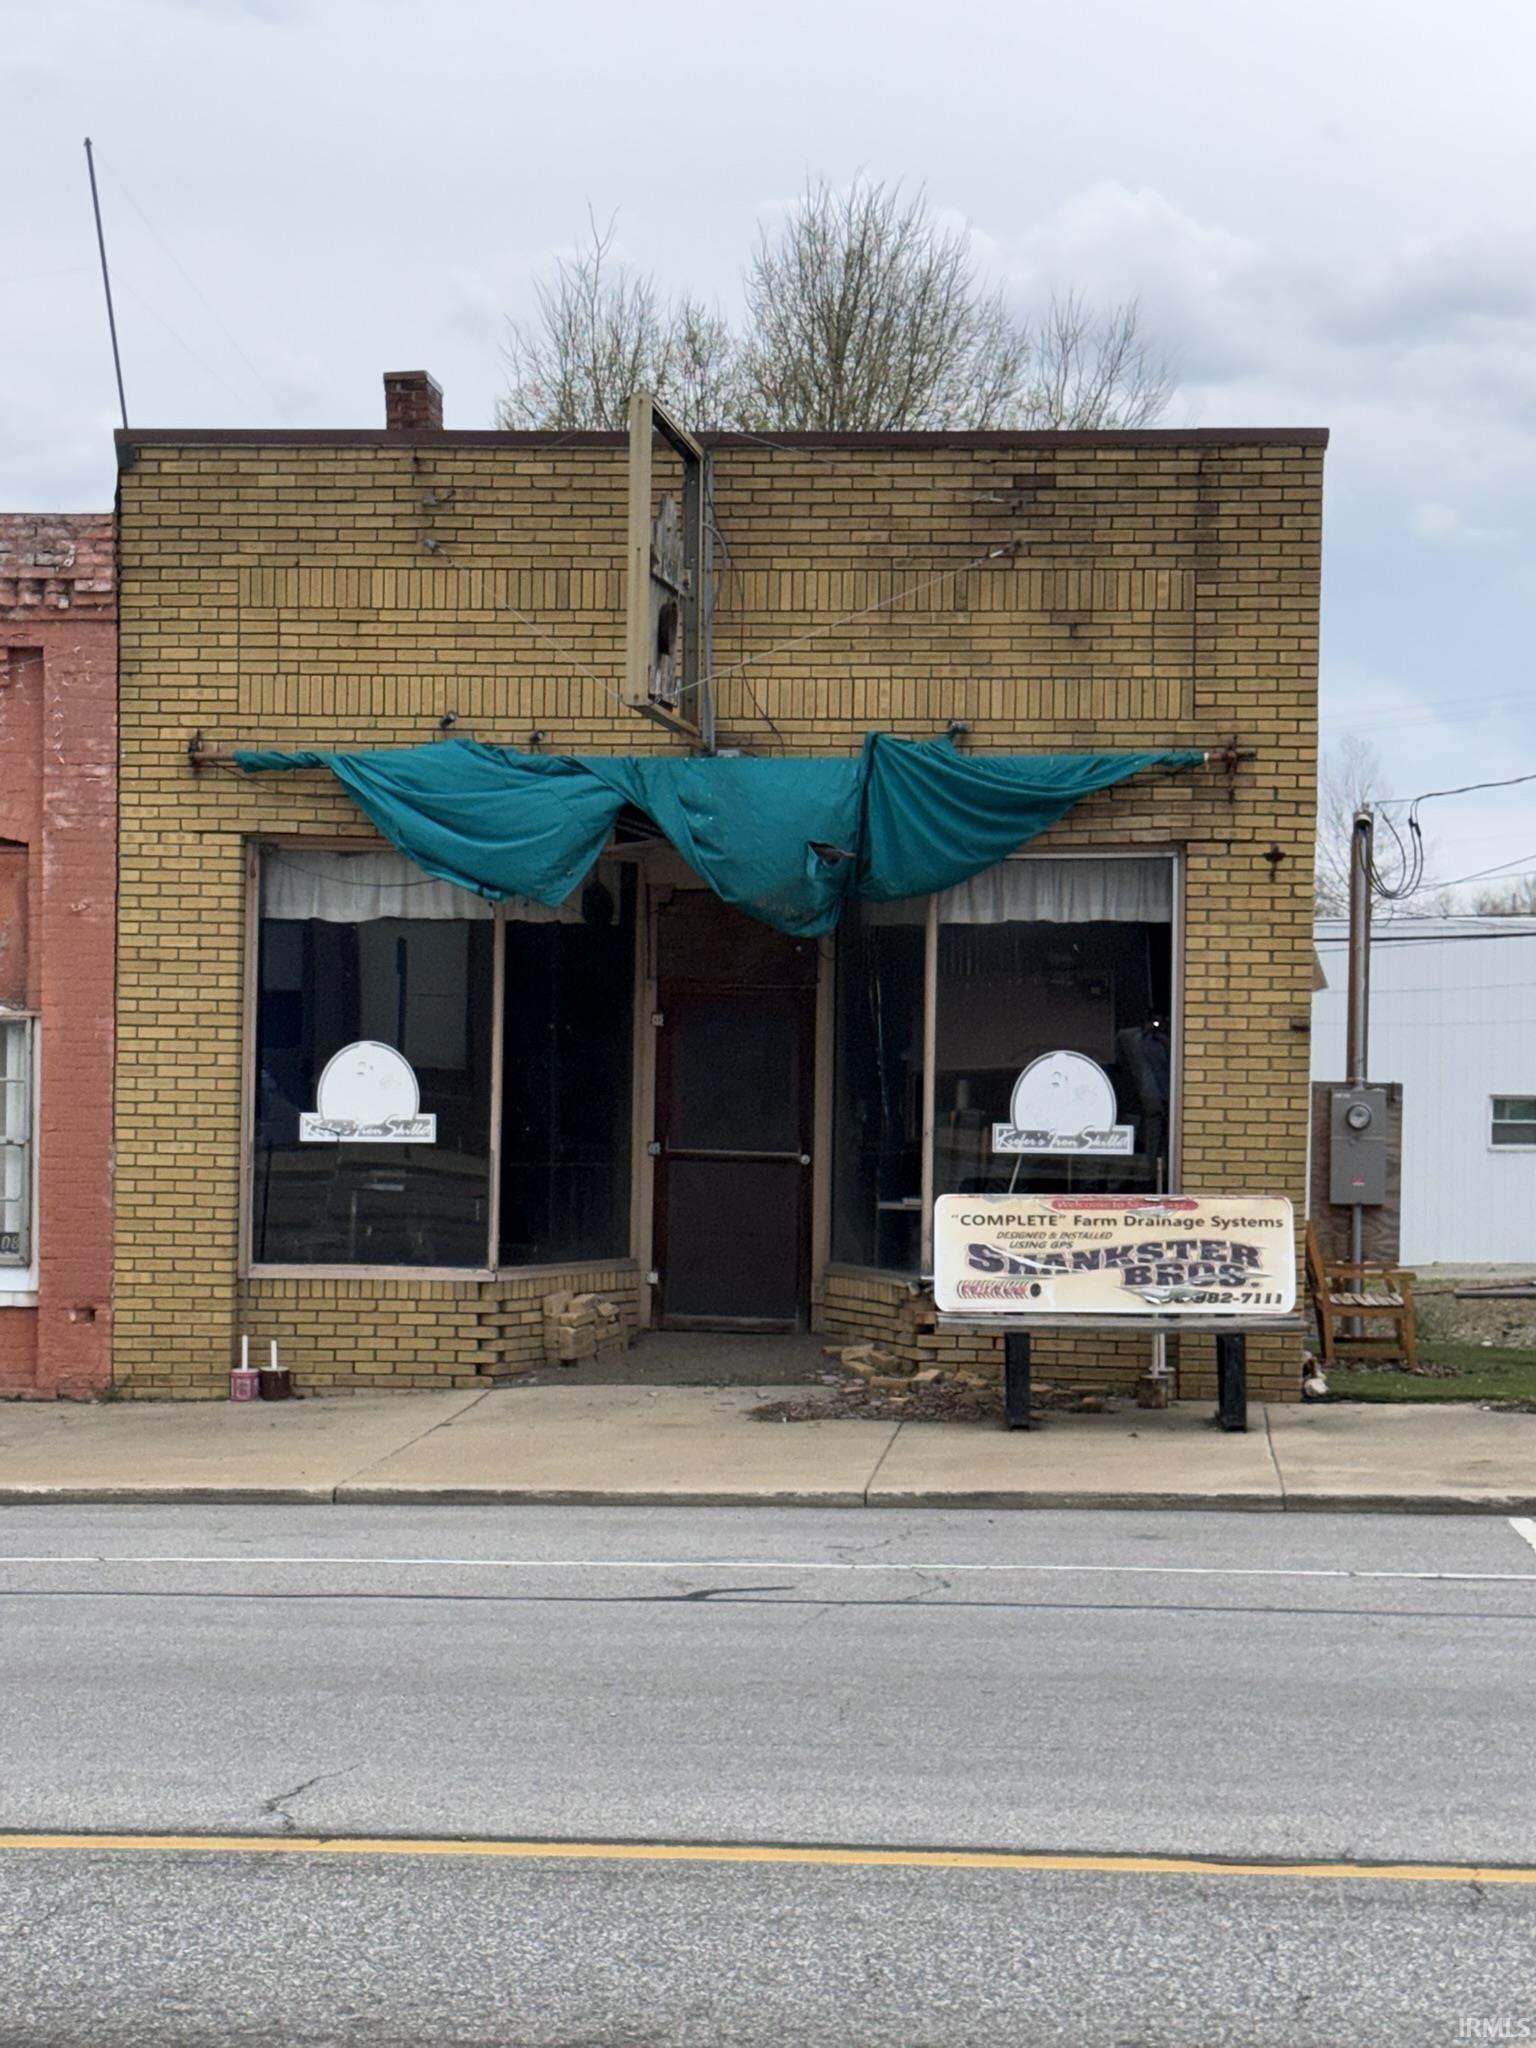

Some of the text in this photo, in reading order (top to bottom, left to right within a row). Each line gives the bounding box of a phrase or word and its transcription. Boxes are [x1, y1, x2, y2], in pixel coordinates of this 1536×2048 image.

[1073, 1215, 1117, 1227] Farm
[1124, 1215, 1205, 1229] Drainage
[1211, 1215, 1284, 1229] Systems
[996, 1231, 1113, 1240] DESIGNED & INSTALLED
[1009, 1241, 1074, 1250] USING GPS
[967, 1239, 1262, 1275] SHANKSTER
